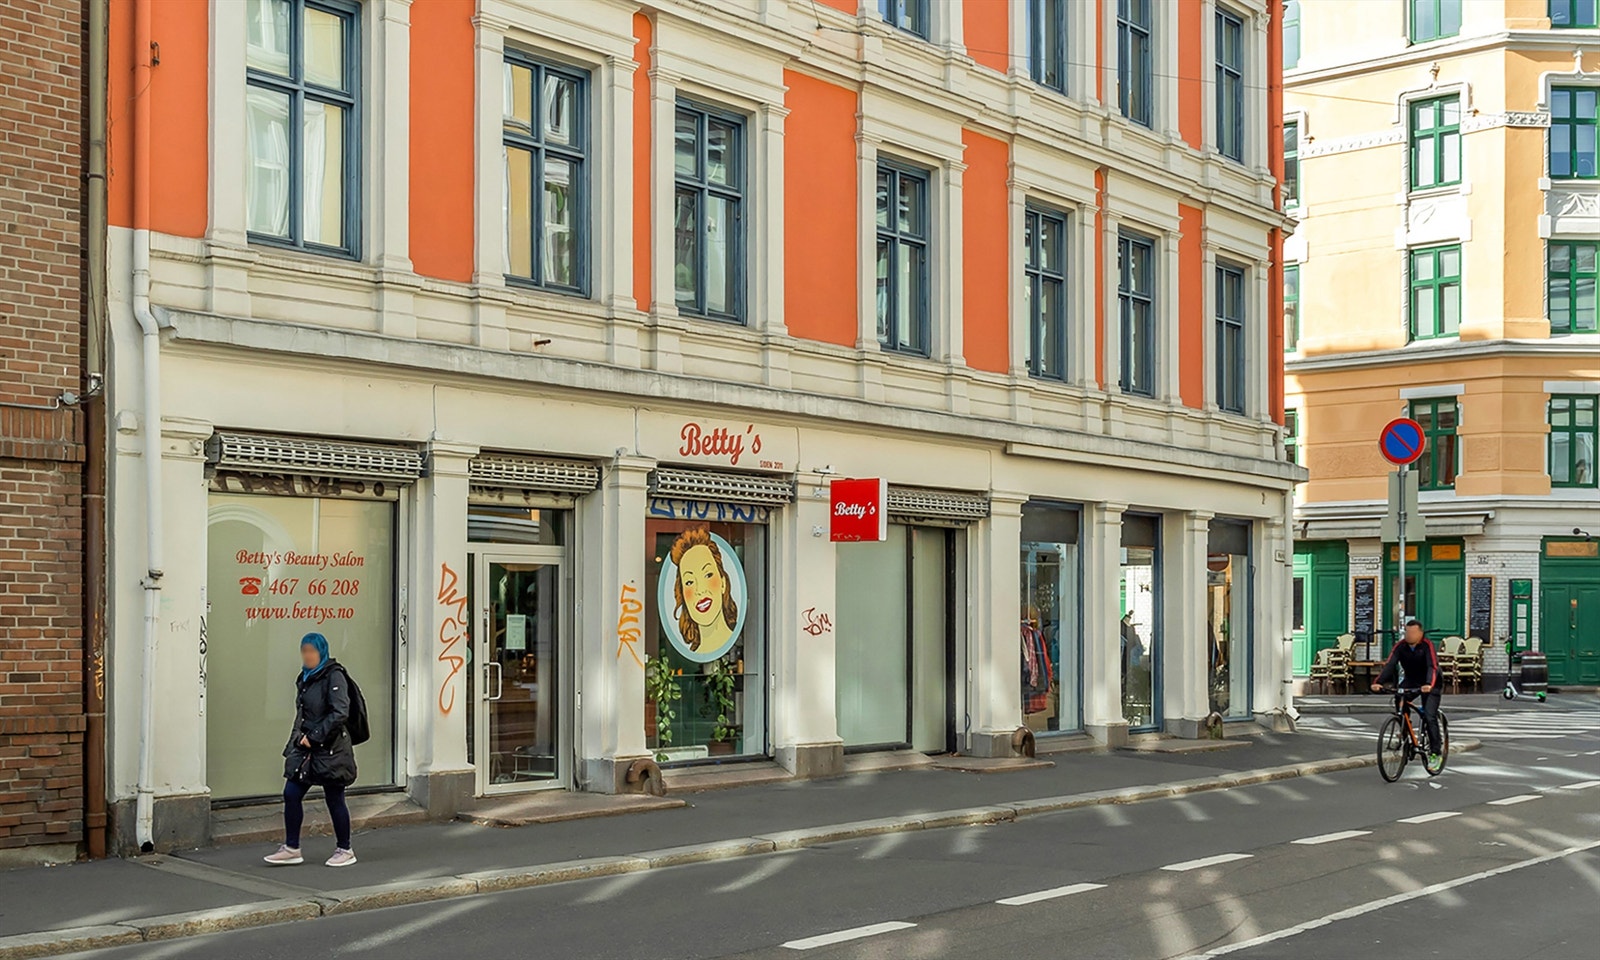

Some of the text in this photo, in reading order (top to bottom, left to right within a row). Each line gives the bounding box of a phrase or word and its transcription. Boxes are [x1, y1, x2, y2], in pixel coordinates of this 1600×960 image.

[235, 549, 365, 570] Betty's Beauty Salon
[268, 578, 360, 596] 467 66 208
[245, 601, 354, 625] www.bettys.no
